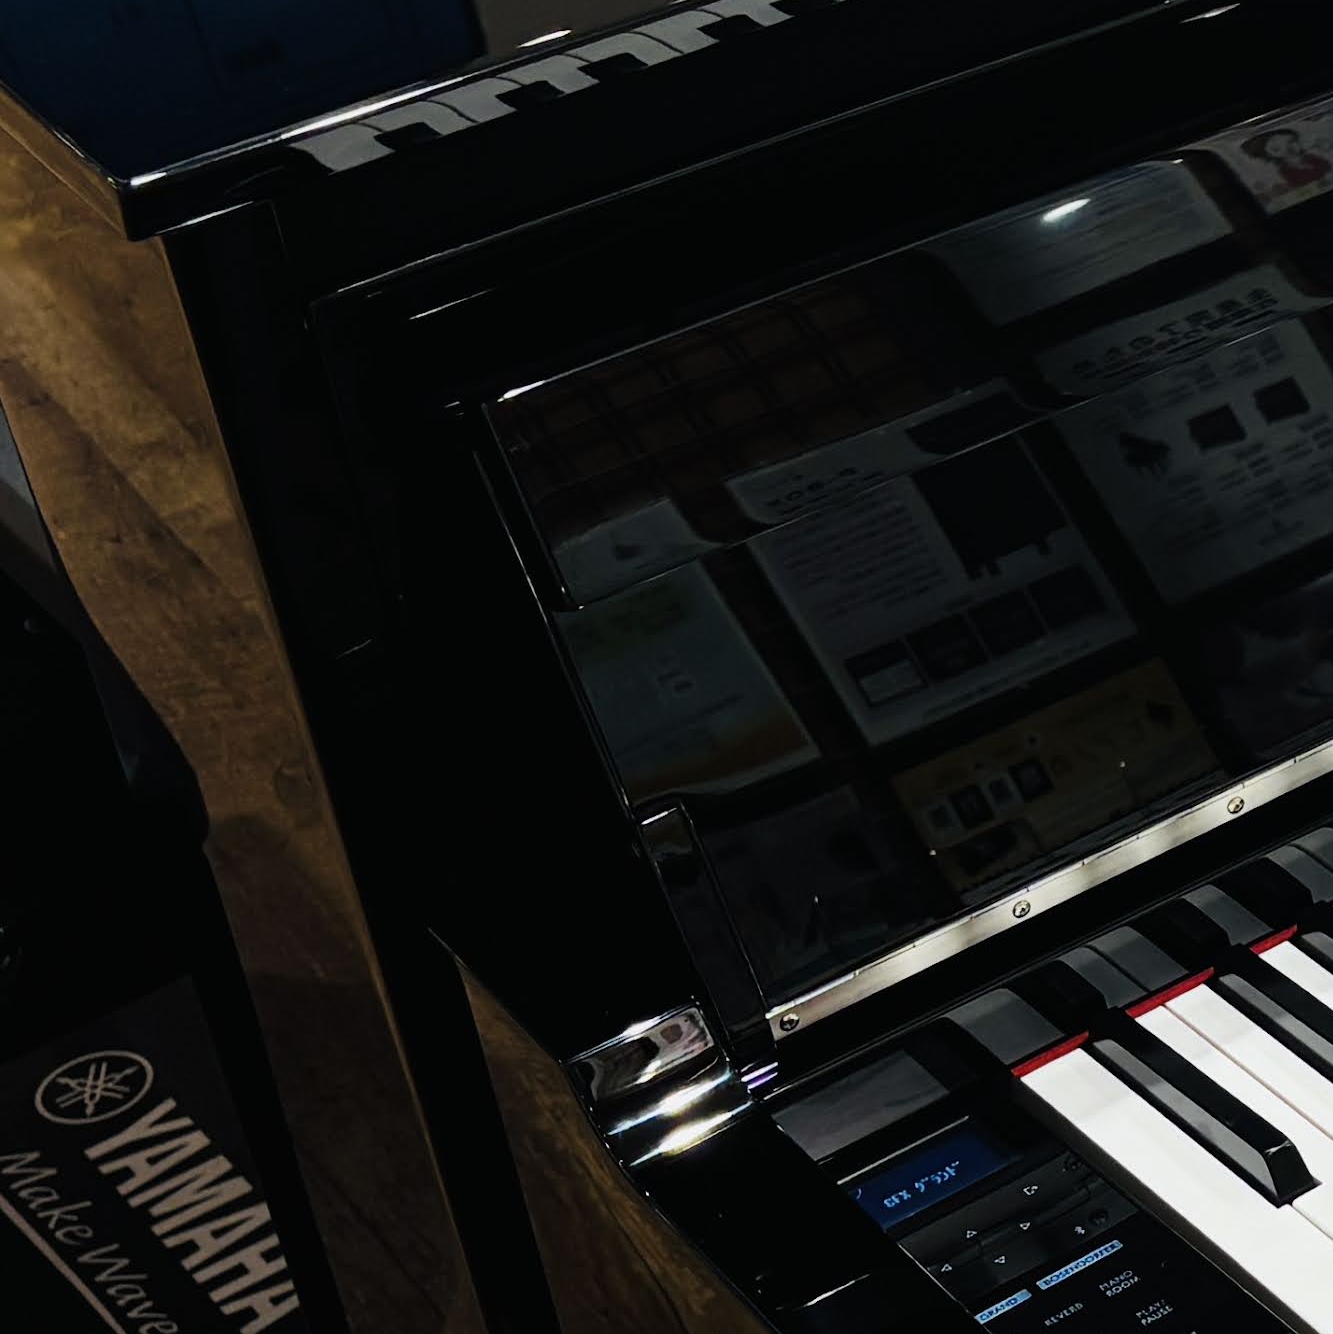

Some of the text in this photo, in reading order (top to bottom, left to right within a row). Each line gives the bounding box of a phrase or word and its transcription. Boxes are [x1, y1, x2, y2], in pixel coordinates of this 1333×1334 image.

[0, 1151, 94, 1246] Make
[1105, 1276, 1141, 1298] ROOM
[979, 1296, 1020, 1322] GRAND
[1043, 1302, 1084, 1327] REVERB
[1140, 1305, 1174, 1327] PAUSE
